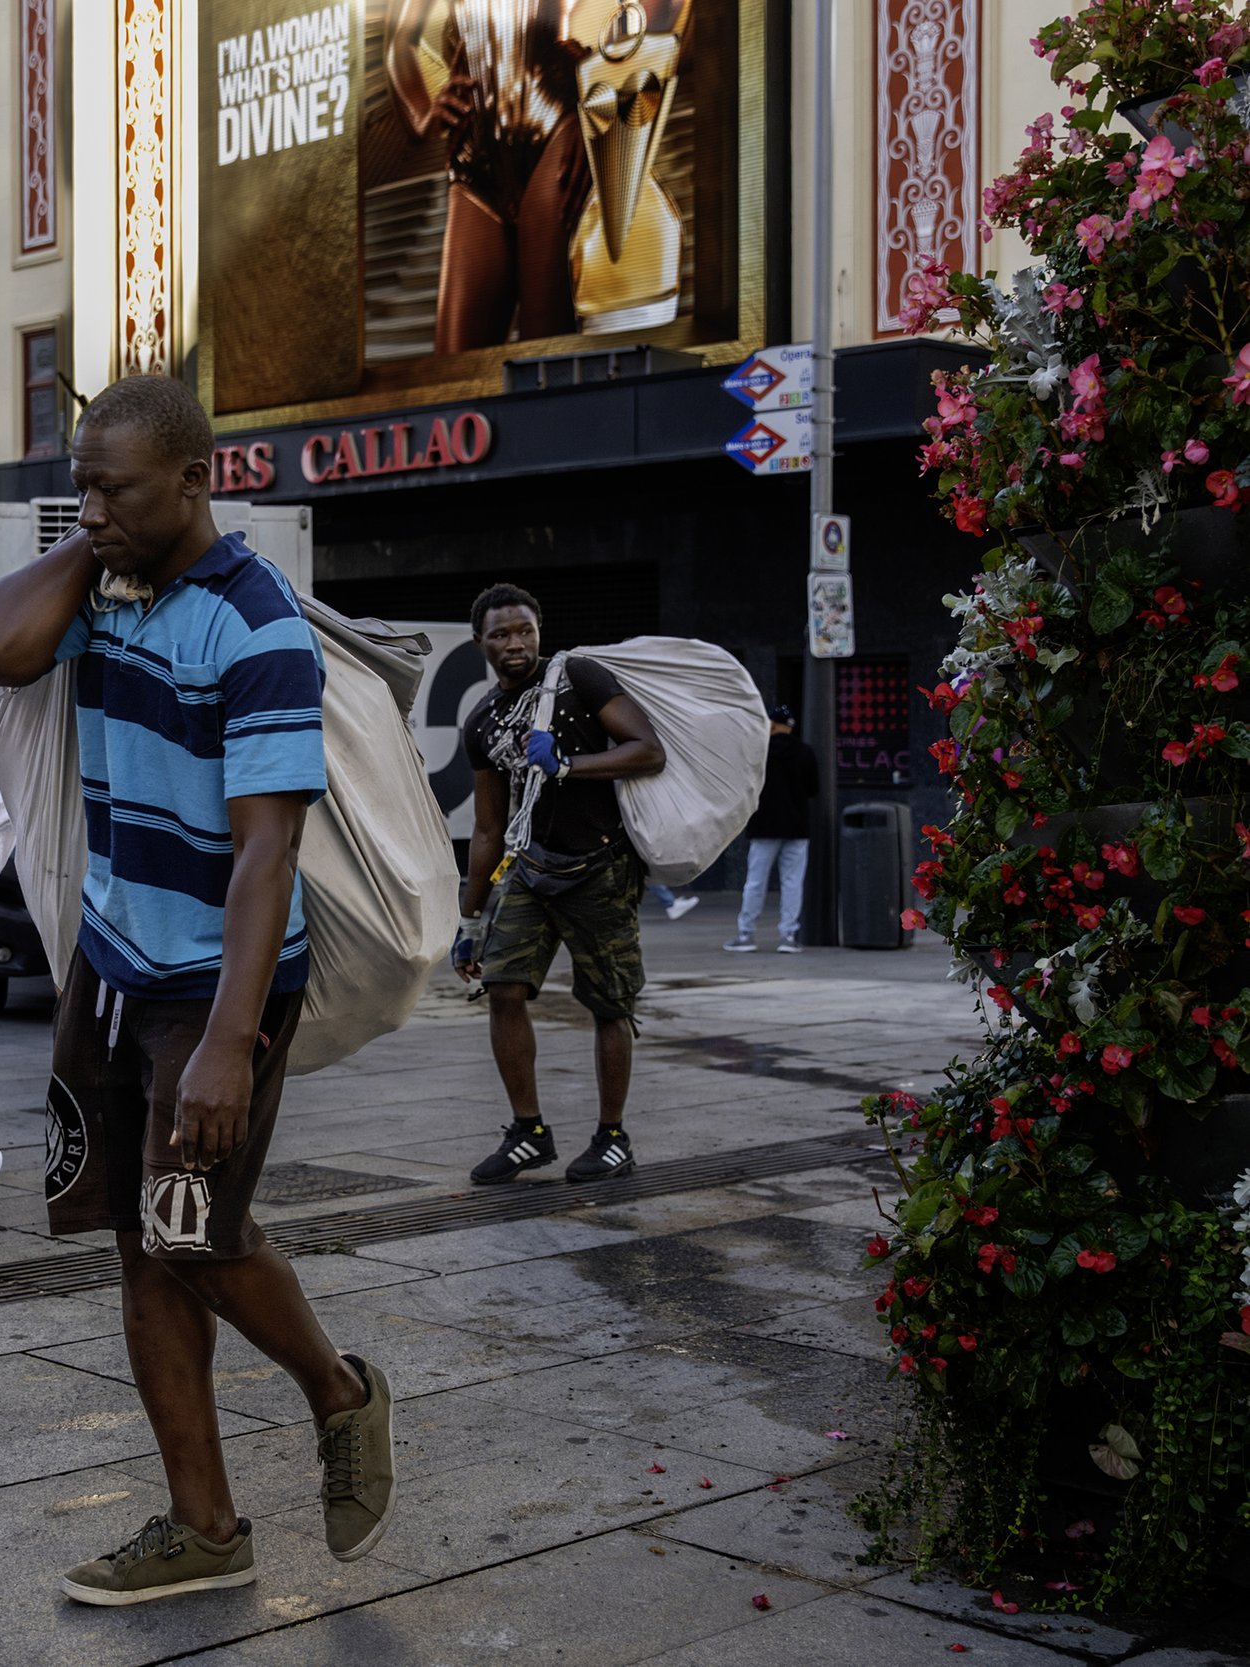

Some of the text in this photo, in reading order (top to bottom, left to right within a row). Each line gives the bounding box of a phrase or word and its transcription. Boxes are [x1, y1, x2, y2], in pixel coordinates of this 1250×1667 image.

[218, 2, 350, 76] I'M A WOMAN
[218, 39, 350, 108] WHAT'S MORE
[218, 75, 350, 167] DIVINE?
[301, 412, 492, 484] CALLAO
[52, 1127, 83, 1188] YORK
